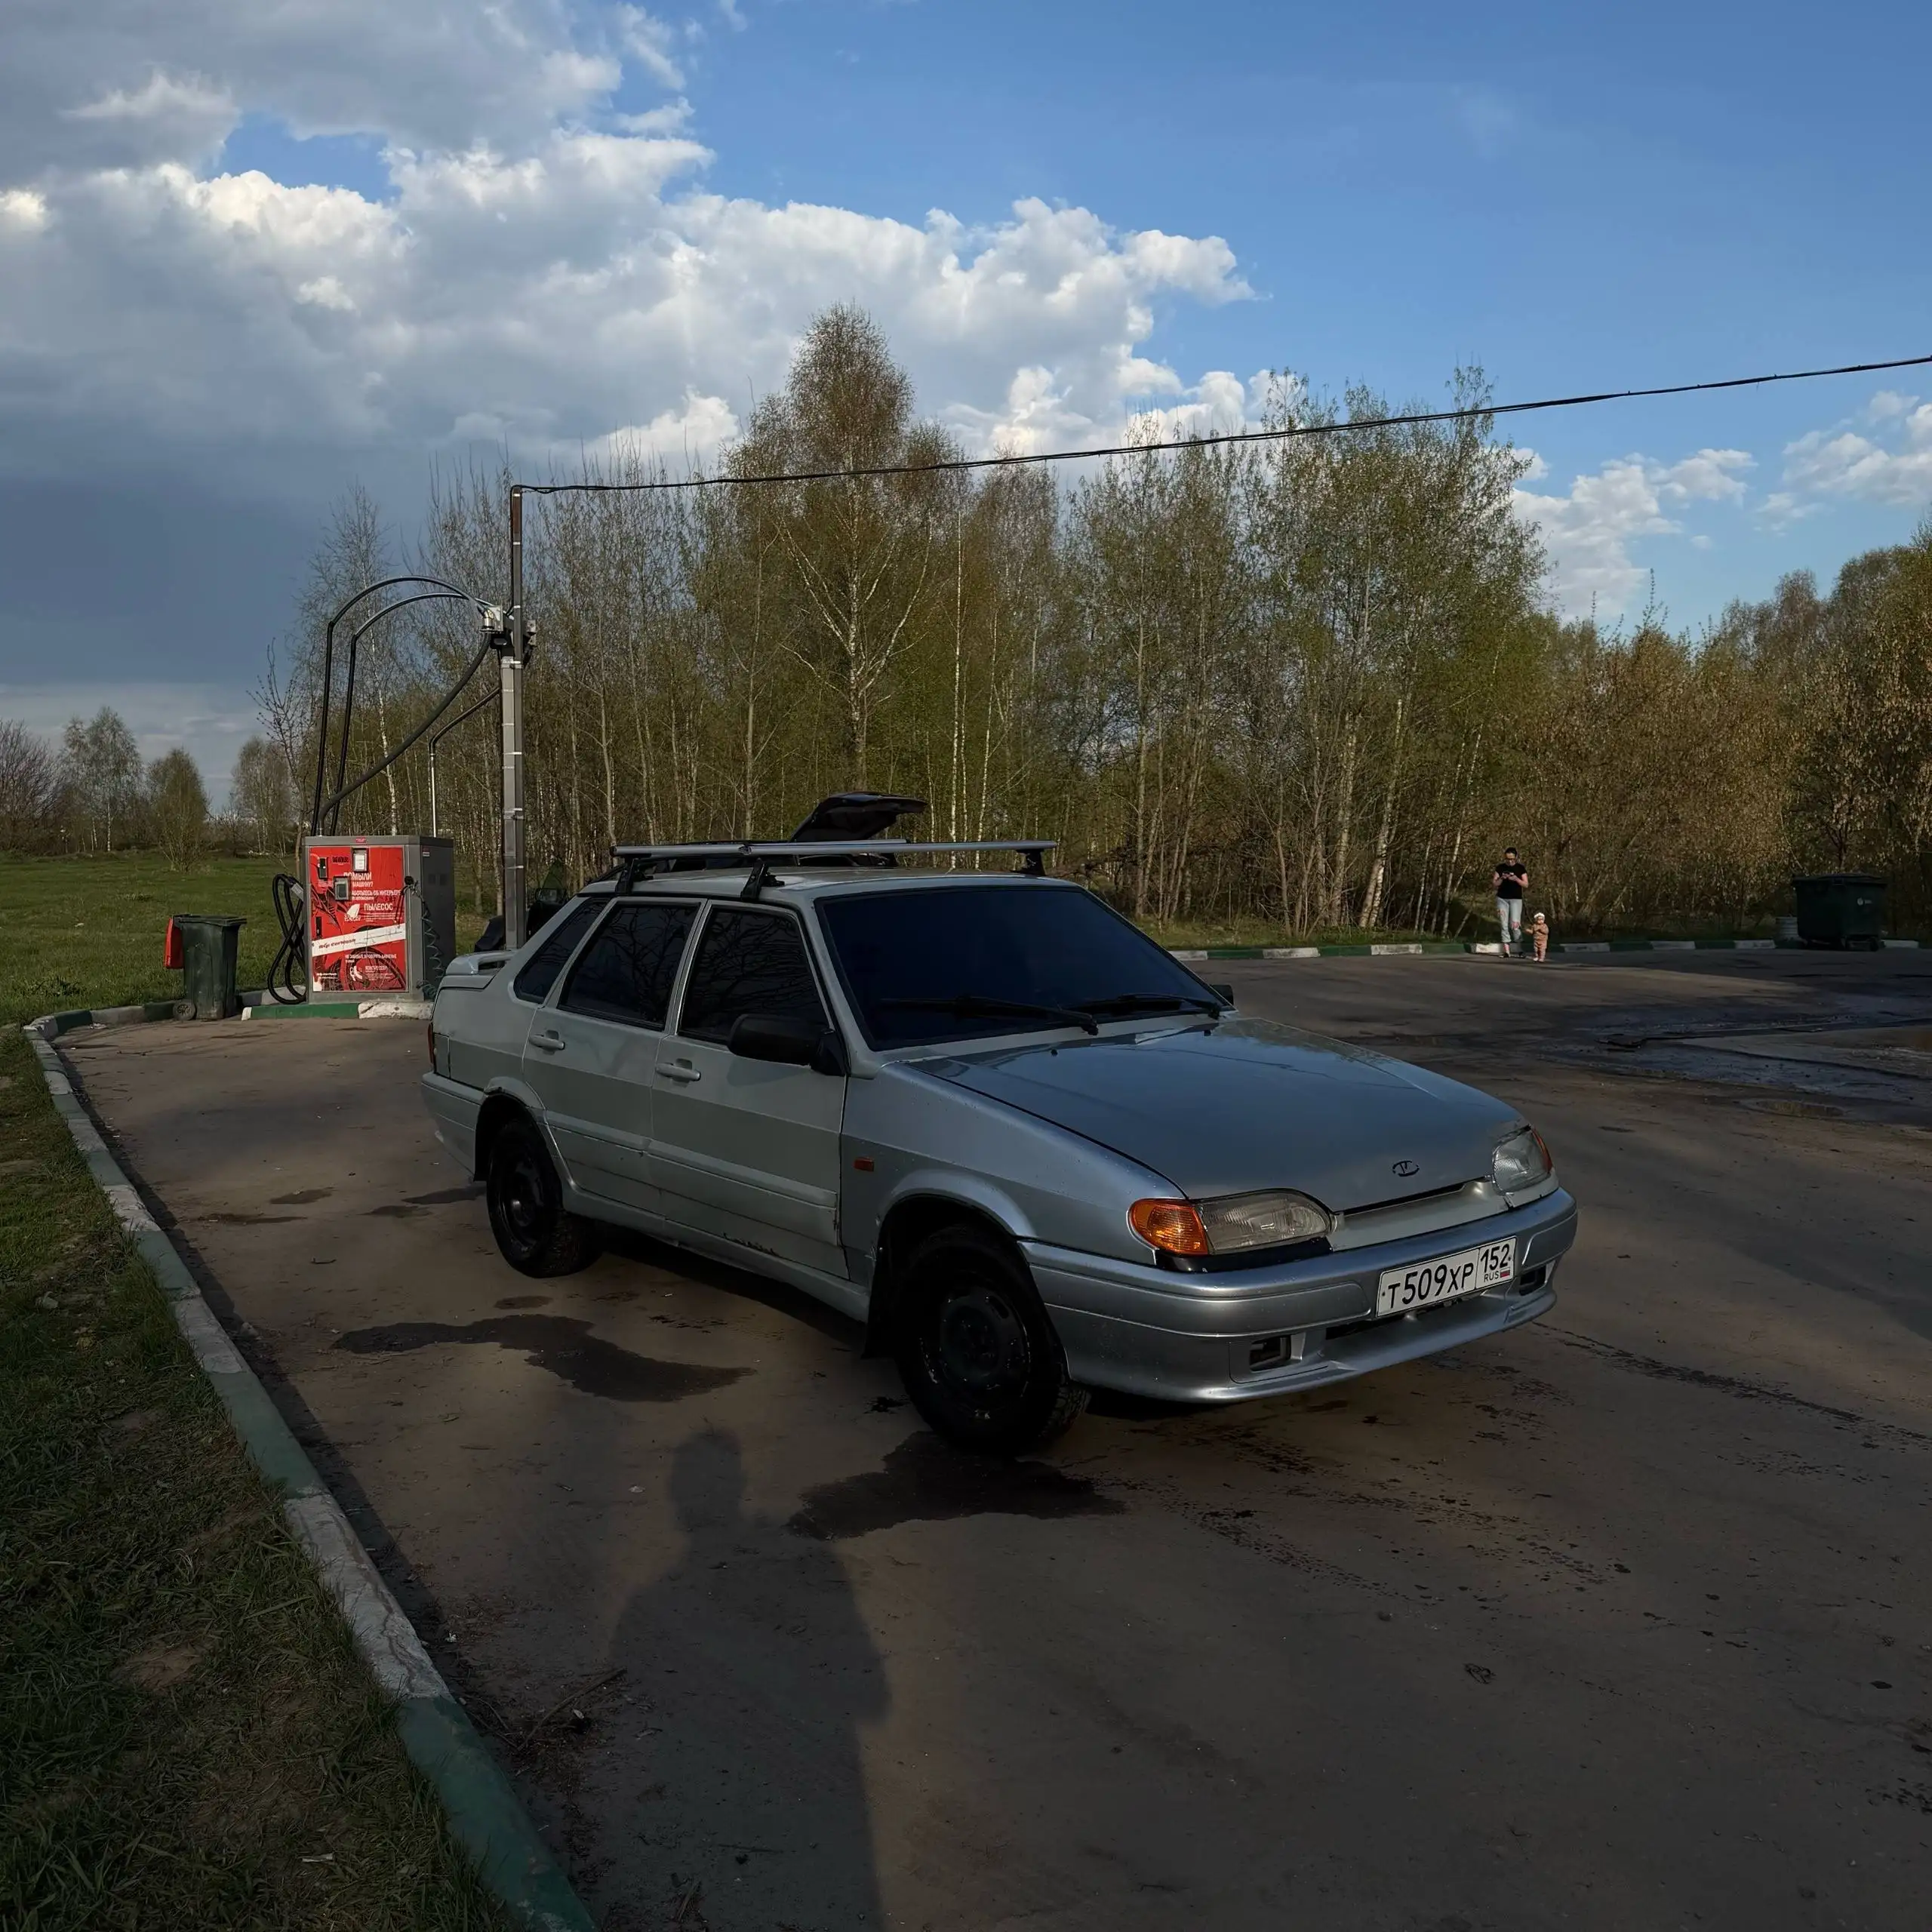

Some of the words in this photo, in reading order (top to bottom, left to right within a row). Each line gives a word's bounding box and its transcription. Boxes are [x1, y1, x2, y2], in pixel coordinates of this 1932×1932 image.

[364, 903, 393, 911] ПЫЛЕСОС
[1480, 1244, 1510, 1273] 152
[1484, 1270, 1500, 1282] RUS
